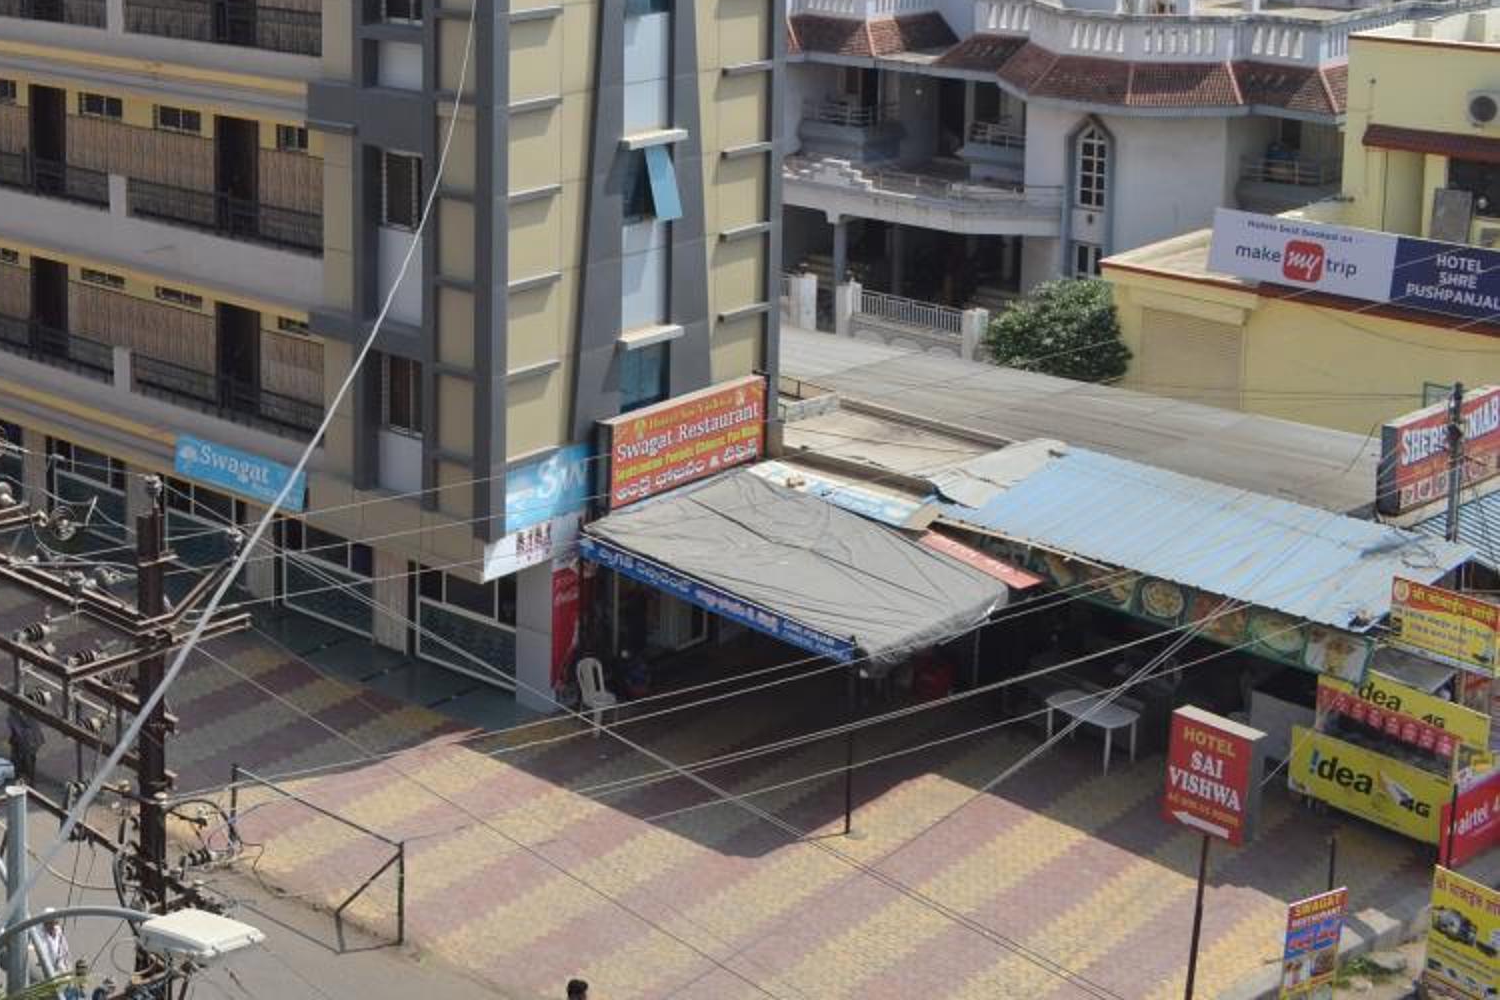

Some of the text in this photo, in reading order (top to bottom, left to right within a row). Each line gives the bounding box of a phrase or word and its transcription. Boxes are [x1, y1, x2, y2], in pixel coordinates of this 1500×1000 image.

[1235, 243, 1358, 280] make my trip
[1436, 253, 1484, 274] HOTEL
[1438, 272, 1478, 290] SHRE
[617, 430, 673, 463] Swagat
[678, 402, 759, 441] Restaurant
[199, 443, 270, 484] Swagat
[1358, 681, 1401, 712] dea
[1182, 726, 1237, 758] HOTEL
[1190, 750, 1224, 780] SAI
[1168, 764, 1241, 812] VISHWA
[1457, 800, 1490, 835] airtel
